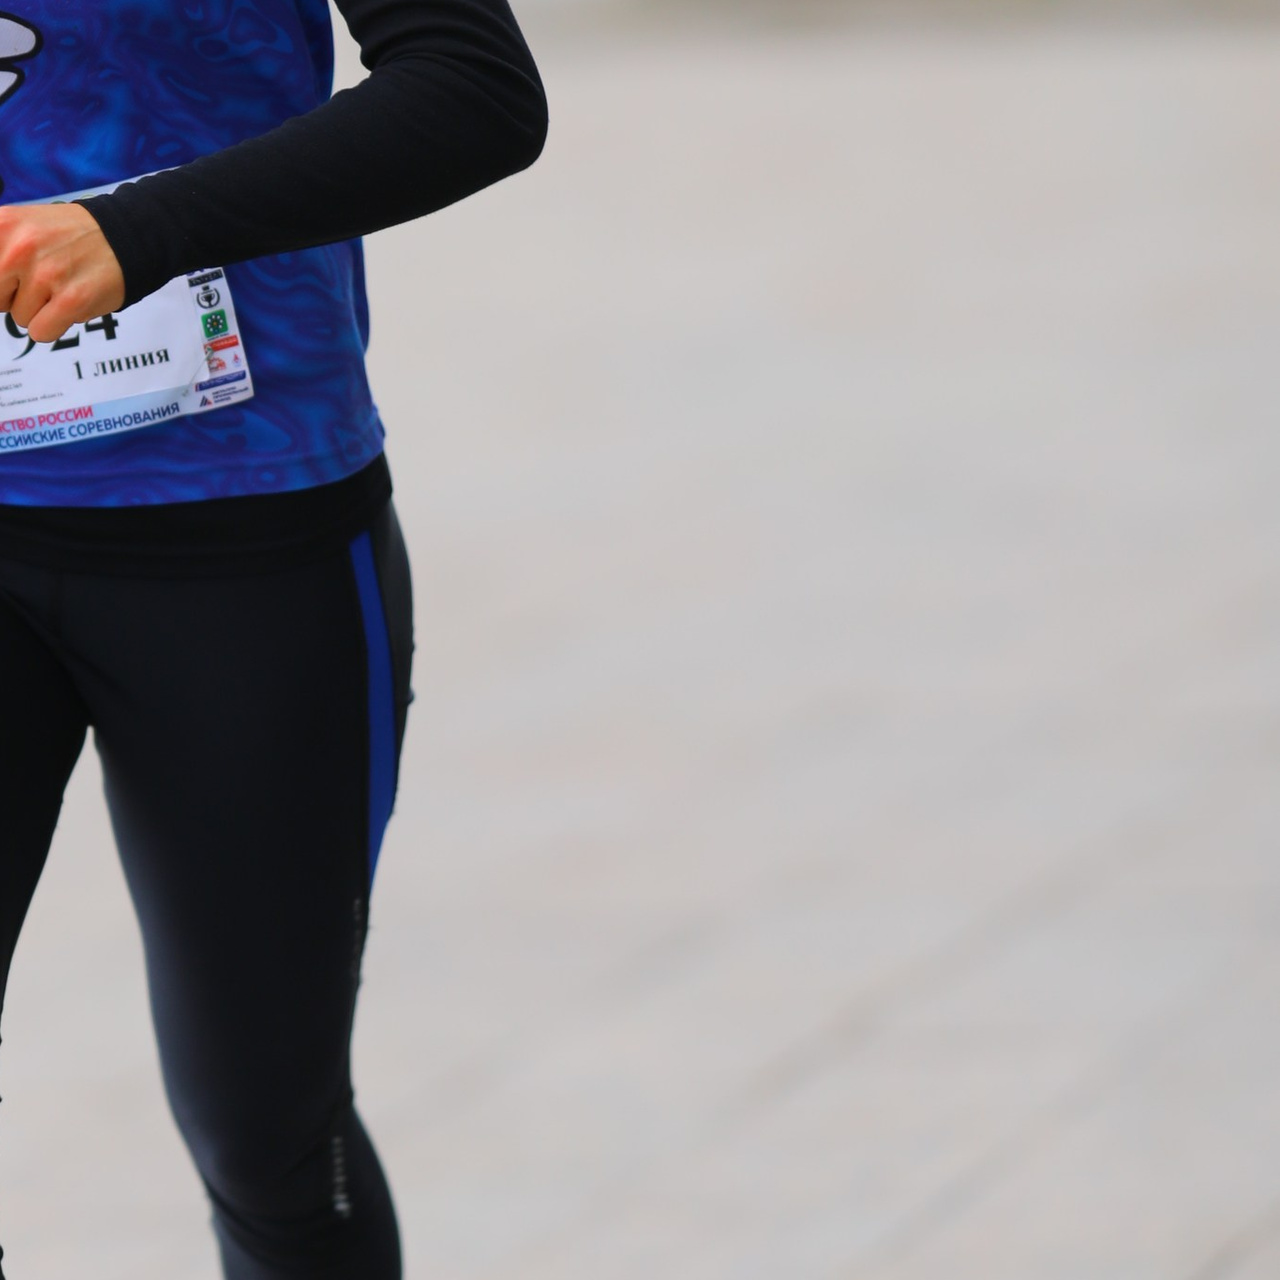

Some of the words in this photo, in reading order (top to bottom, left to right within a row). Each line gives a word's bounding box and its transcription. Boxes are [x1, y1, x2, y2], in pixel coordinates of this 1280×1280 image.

[4, 312, 119, 361] 94
[73, 360, 83, 380] 1
[93, 348, 170, 377] линия
[37, 405, 94, 428] РОССИИ
[68, 401, 181, 438] СОРЕВНОВАНИЯ
